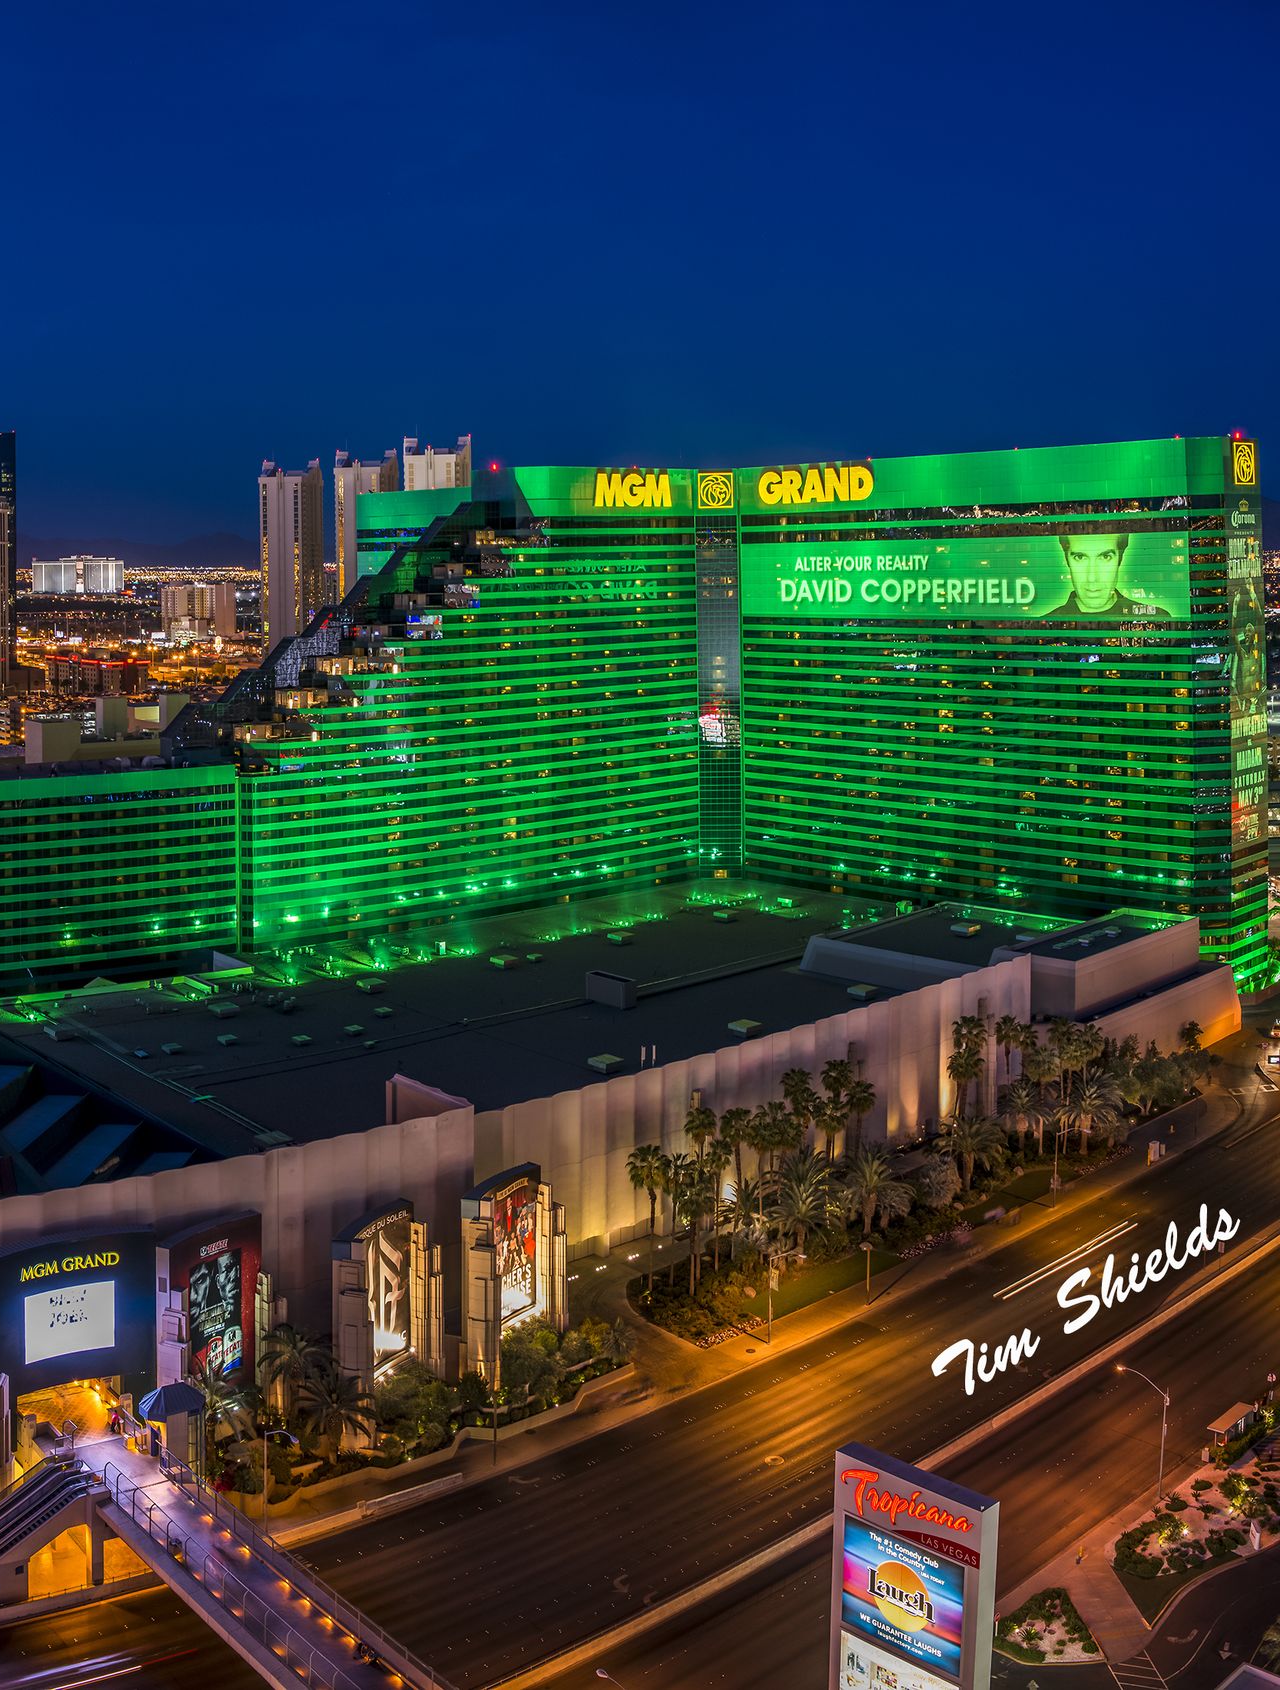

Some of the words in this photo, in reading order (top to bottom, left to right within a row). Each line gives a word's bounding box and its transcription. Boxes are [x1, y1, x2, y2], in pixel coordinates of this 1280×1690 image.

[594, 472, 672, 508] MGM
[758, 465, 873, 505] GRAND
[1231, 510, 1256, 529] Corona
[795, 556, 832, 572] ALTER
[836, 556, 872, 571] YOUR
[877, 555, 929, 571] REALITY
[780, 577, 855, 605] DAVID
[861, 575, 1036, 605] COPPERFIELD
[386, 1210, 409, 1225] SOLEIL
[20, 1260, 60, 1283] MGM
[62, 1252, 120, 1272] GRAND
[502, 1263, 531, 1290] CHER'S
[841, 1468, 974, 1533] Tropicana
[869, 1531, 882, 1543] The
[884, 1539, 893, 1549] #1
[894, 1543, 922, 1562] Comedy
[923, 1555, 939, 1569] Club
[886, 1546, 898, 1558] the
[898, 1553, 926, 1571] Country
[921, 1534, 939, 1549] LAS
[941, 1543, 977, 1566] VEGAS
[867, 1566, 936, 1623] Laugh
[860, 1612, 871, 1624] WE
[872, 1618, 913, 1644] GUARANTEE
[913, 1636, 942, 1658] LAUGHS
[877, 1630, 924, 1656] laughfactory.com
